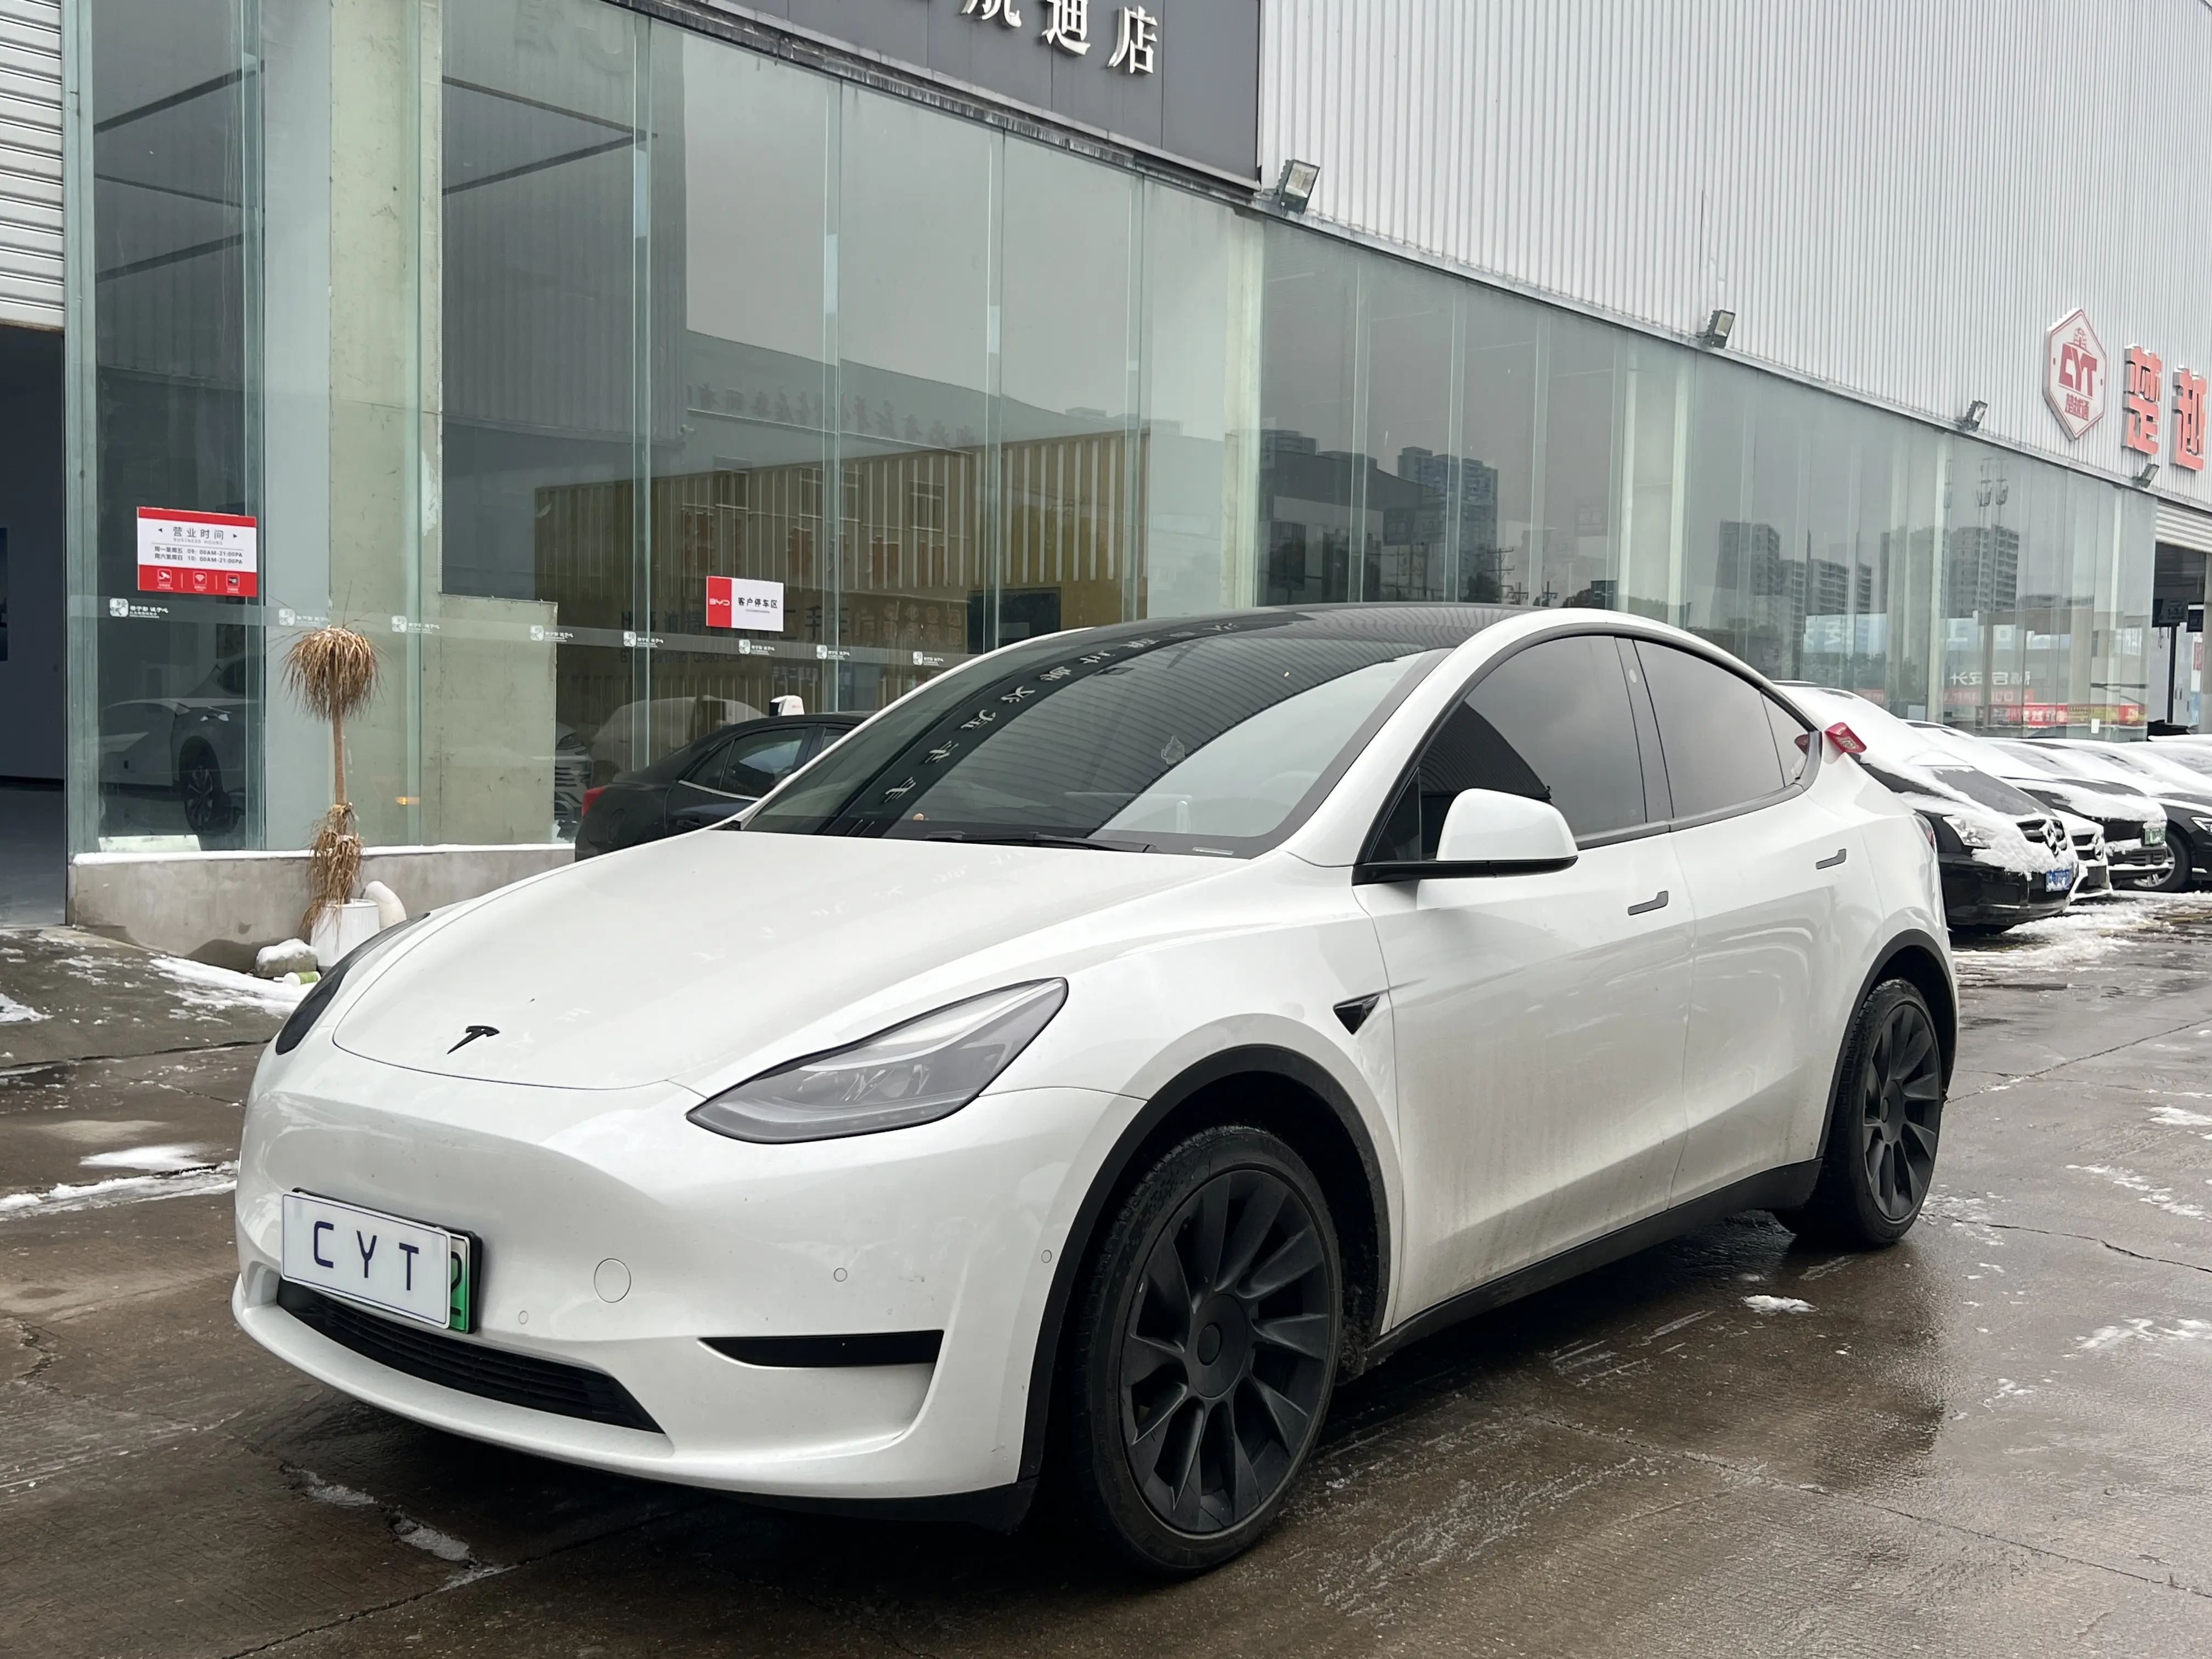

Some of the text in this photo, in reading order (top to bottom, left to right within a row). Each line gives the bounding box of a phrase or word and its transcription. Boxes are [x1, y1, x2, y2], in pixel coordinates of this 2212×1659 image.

[2059, 343, 2097, 397] CYT
[173, 527, 224, 541] 营业时间
[154, 546, 183, 554] 周一至周五
[709, 598, 730, 606] BYD
[738, 597, 778, 609] 客户停车区
